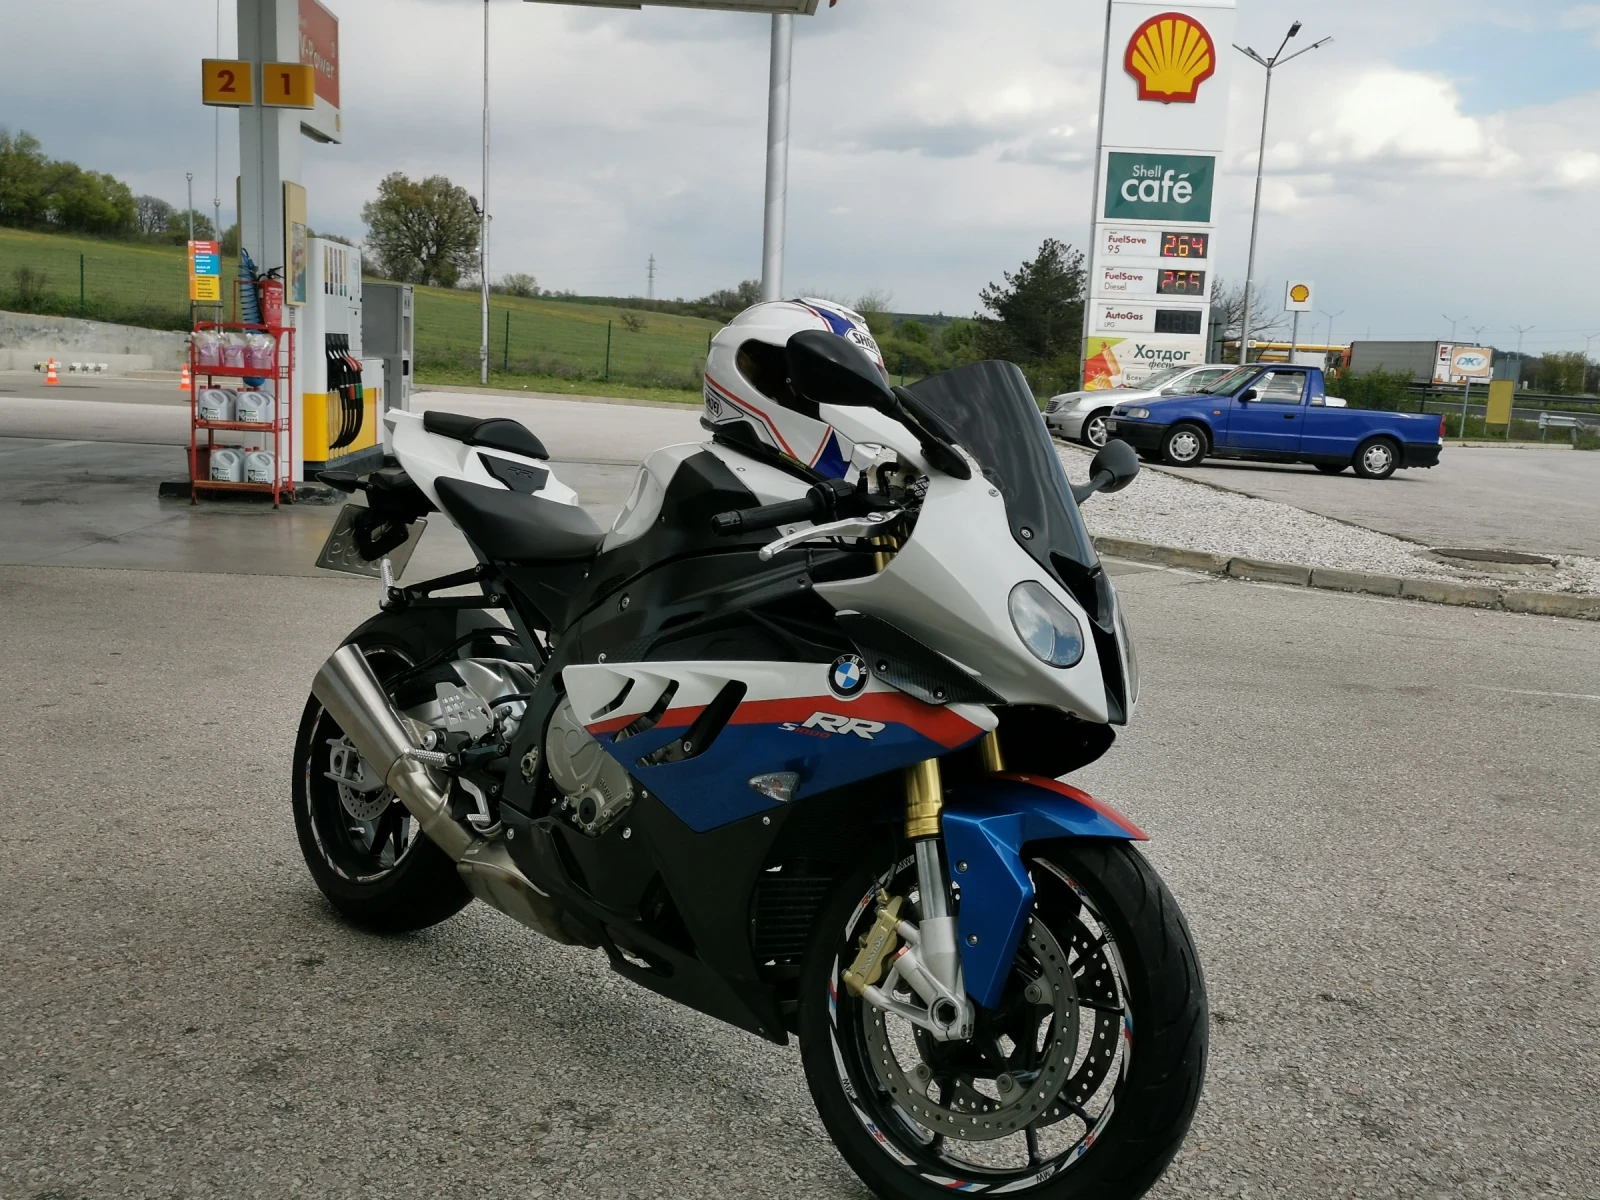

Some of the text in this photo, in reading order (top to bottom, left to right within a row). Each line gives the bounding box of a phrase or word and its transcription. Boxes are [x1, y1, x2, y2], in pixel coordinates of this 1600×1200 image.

[217, 69, 236, 93] 2
[280, 73, 291, 95] 1
[1132, 164, 1162, 178] Shell
[1121, 169, 1193, 204] café
[1108, 235, 1147, 245] FuelSave
[1164, 235, 1203, 257] 2.64
[1107, 245, 1120, 254] 95
[1104, 272, 1143, 281] FuelSave
[1104, 282, 1127, 291] Diesel
[1105, 311, 1143, 321] AutoGas
[1134, 344, 1190, 362] Хотдог
[1456, 357, 1486, 367] DKV
[1126, 373, 1145, 382] Всек
[837, 656, 867, 675] BMW
[801, 711, 886, 740] RR
